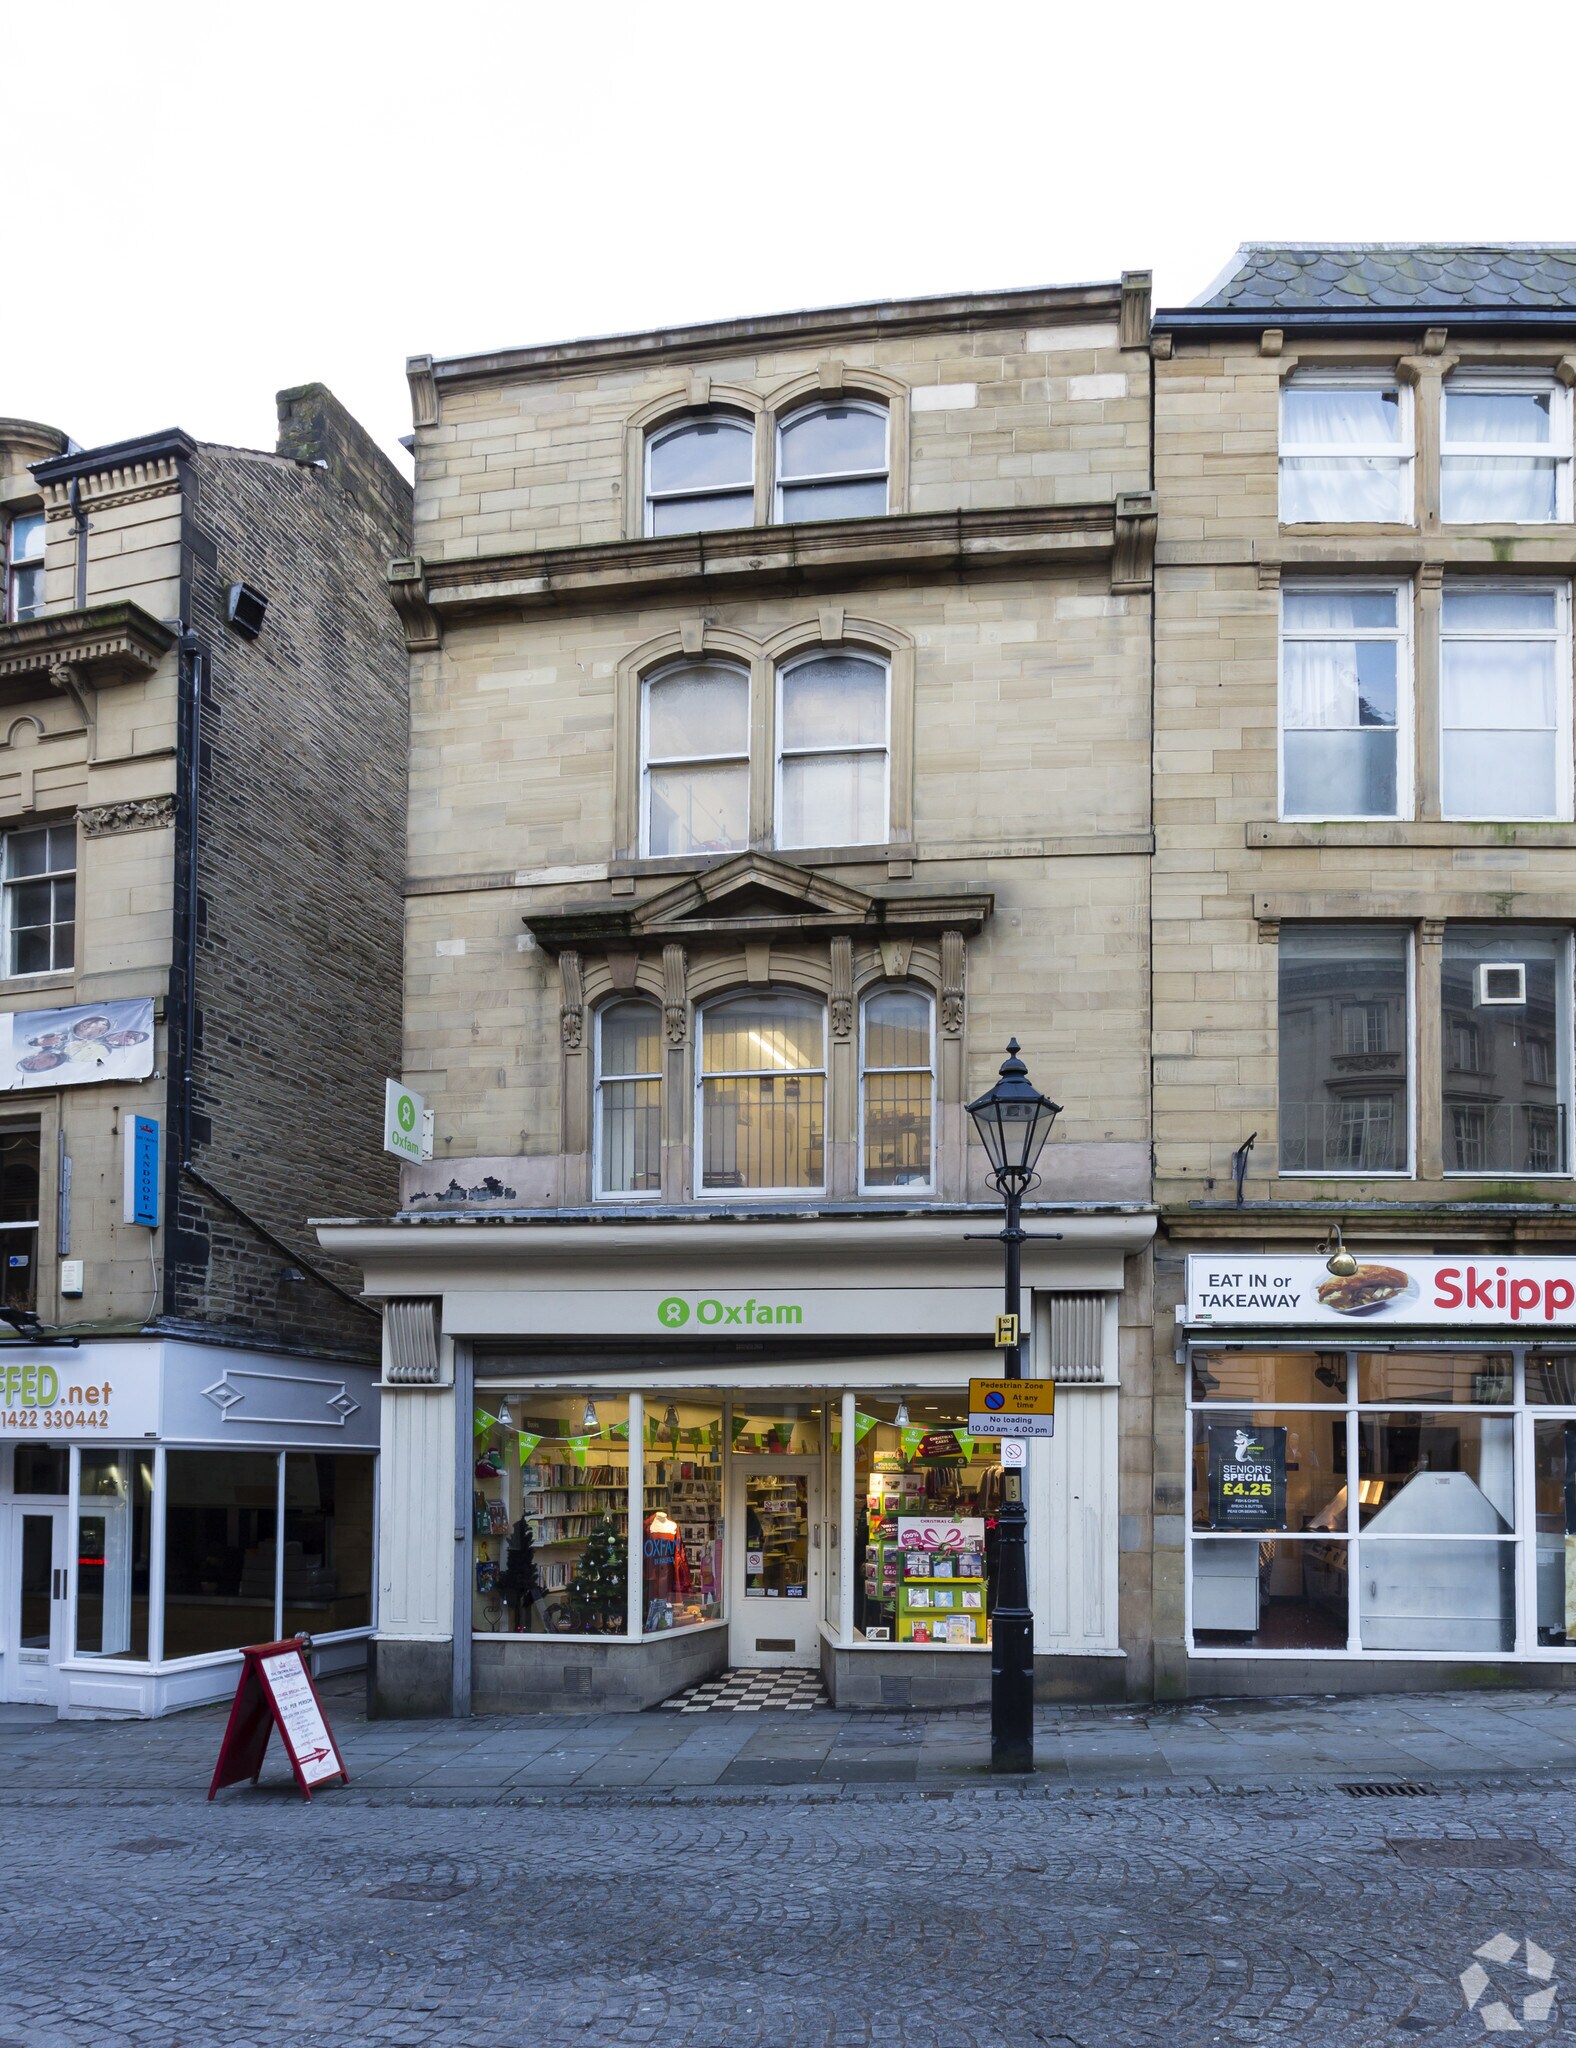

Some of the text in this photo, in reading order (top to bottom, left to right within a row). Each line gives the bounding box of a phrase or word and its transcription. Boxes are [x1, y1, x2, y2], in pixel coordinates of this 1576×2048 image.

[392, 1130, 419, 1156] Oxfam
[1208, 1274, 1292, 1288] EAT IN or
[1199, 1294, 1301, 1308] TAKEAWAY
[696, 1299, 803, 1325] Oxfam
[43, 1409, 109, 1429] 330442
[1223, 1465, 1272, 1474] SENIOR'S
[1223, 1482, 1272, 1496] £4.25
